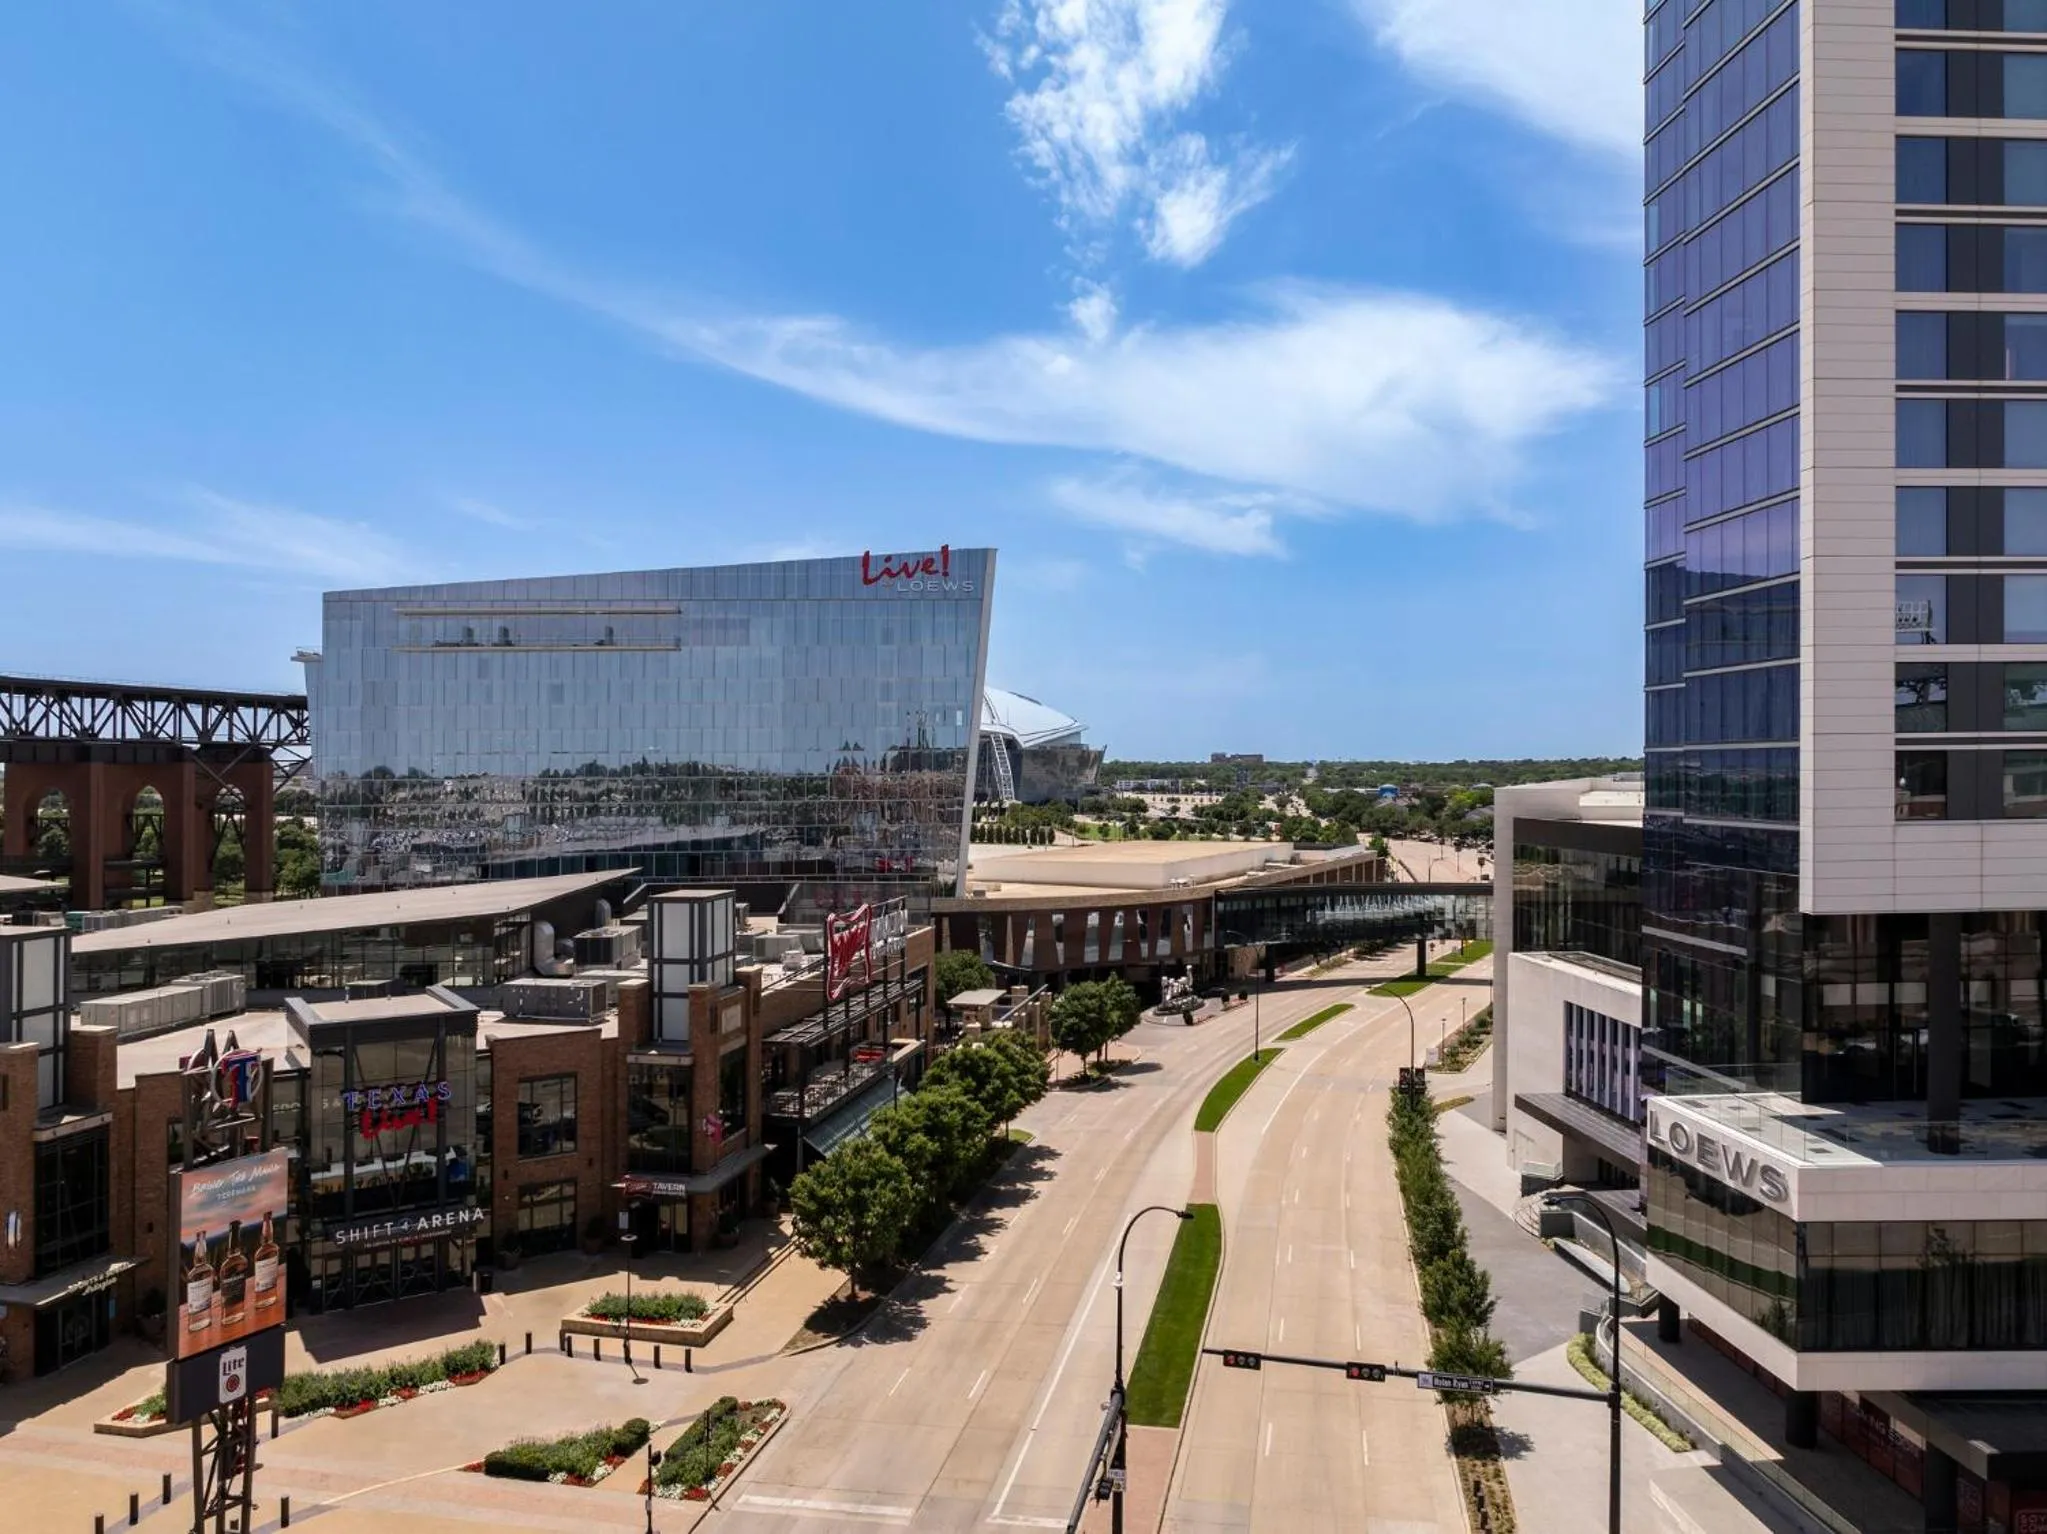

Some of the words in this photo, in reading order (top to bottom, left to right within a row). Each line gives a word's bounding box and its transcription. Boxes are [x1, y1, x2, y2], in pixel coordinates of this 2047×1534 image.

[862, 544, 950, 586] Live!
[897, 580, 975, 593] LOEWS
[342, 1081, 452, 1111] TEXAS
[1649, 1109, 1790, 1203] LOEWS
[653, 1182, 686, 1191] TAVERN
[335, 1222, 393, 1245] SHIFT
[417, 1207, 485, 1231] ARENA
[223, 1356, 245, 1376] Lite
